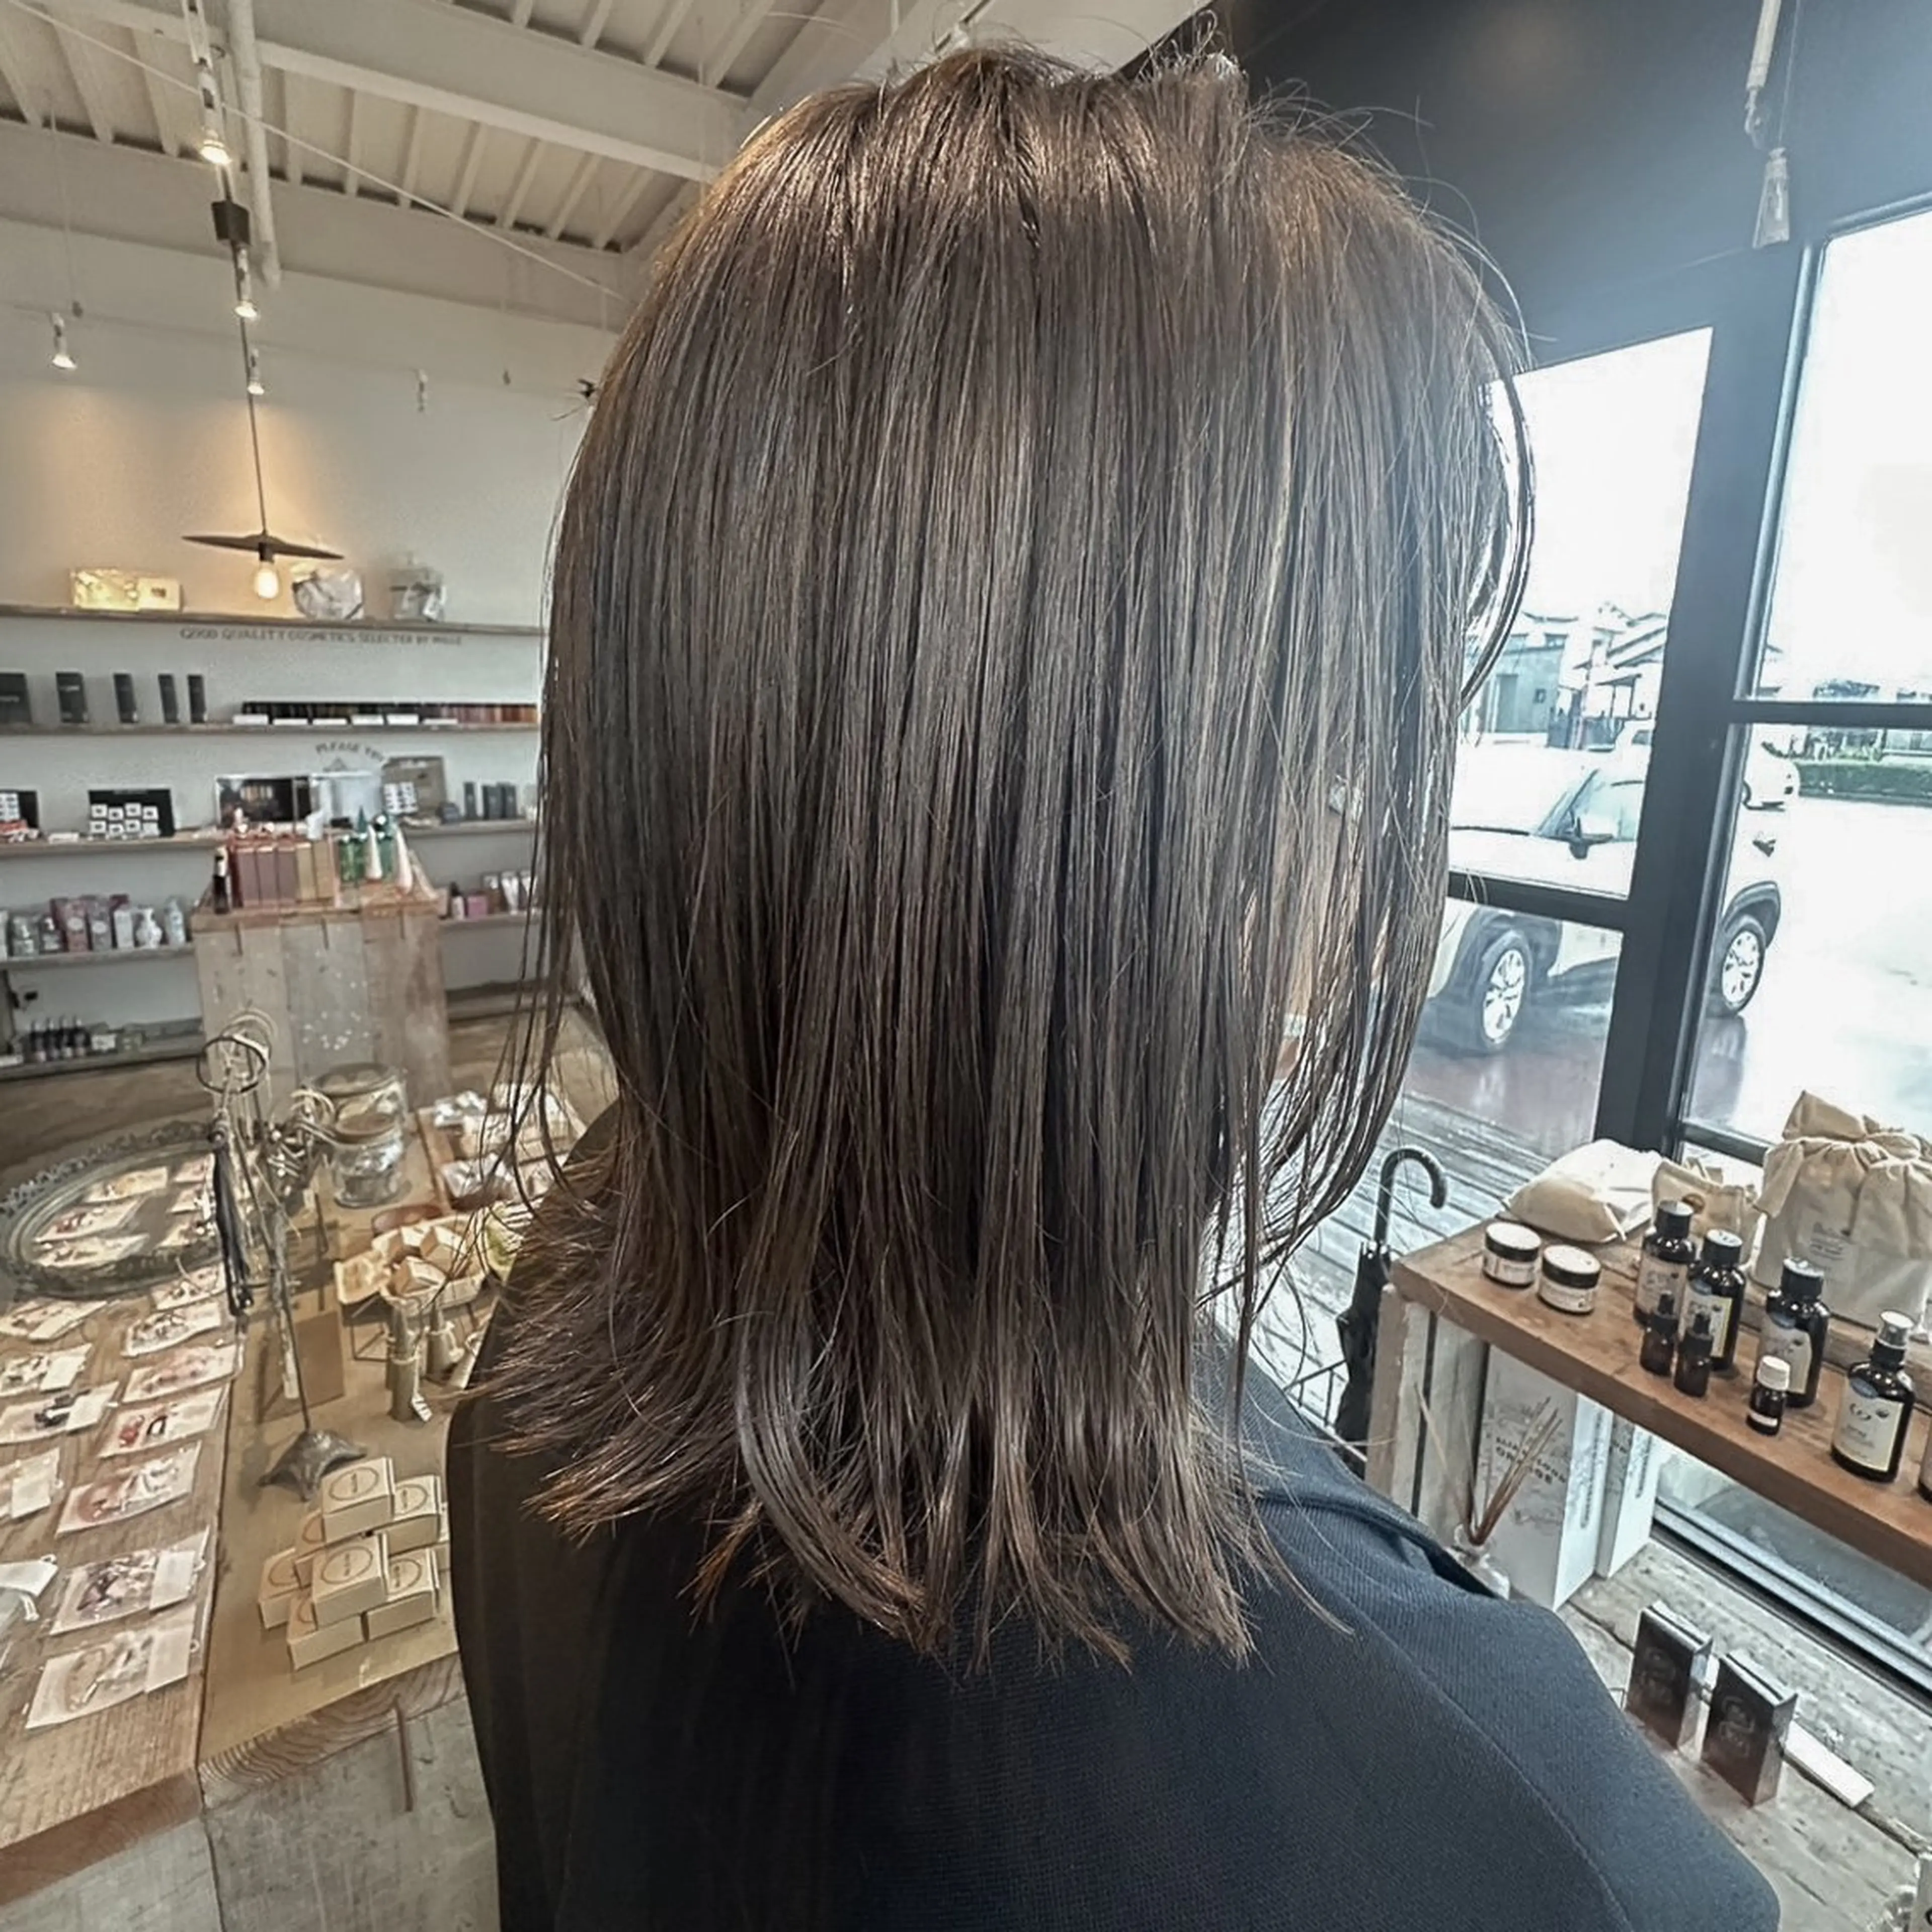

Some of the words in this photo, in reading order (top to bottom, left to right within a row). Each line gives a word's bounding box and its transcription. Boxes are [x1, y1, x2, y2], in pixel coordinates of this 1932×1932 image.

[180, 628, 218, 640] GOOD
[221, 628, 285, 641] QUALITY
[288, 630, 355, 643] COSMETICS
